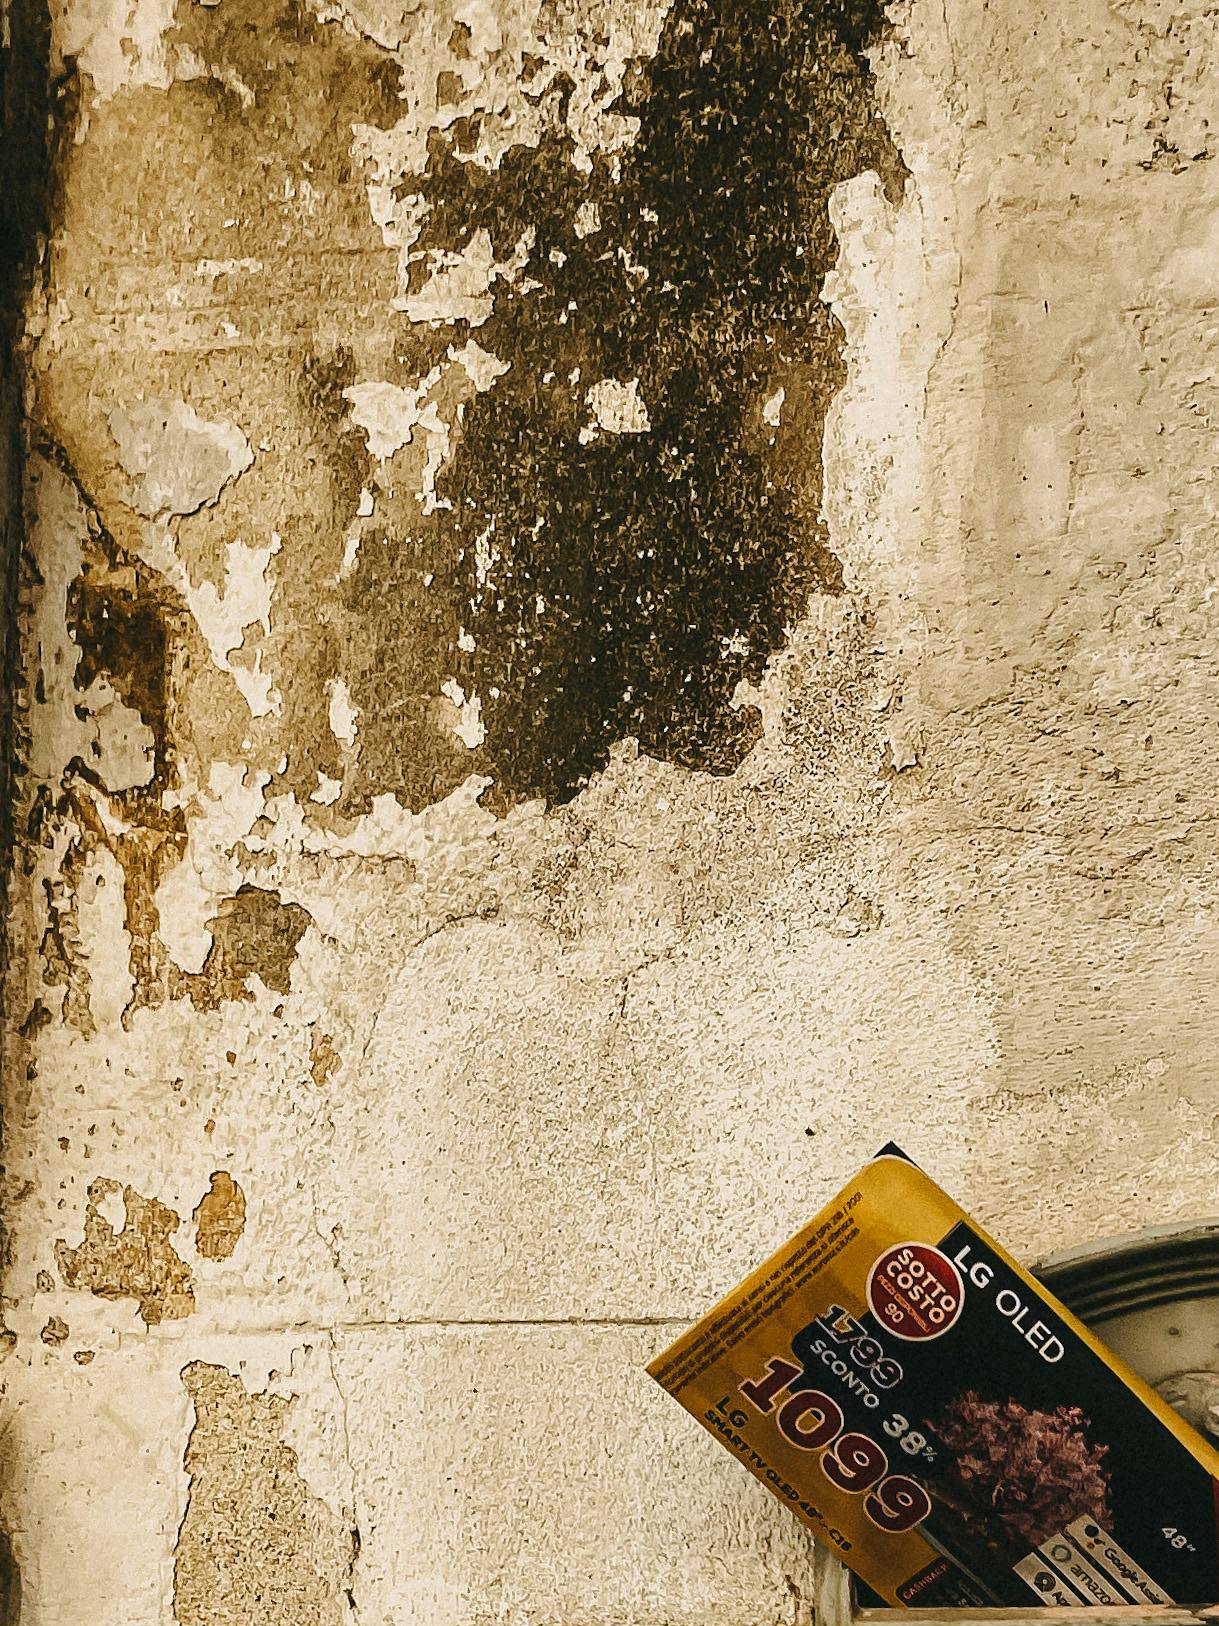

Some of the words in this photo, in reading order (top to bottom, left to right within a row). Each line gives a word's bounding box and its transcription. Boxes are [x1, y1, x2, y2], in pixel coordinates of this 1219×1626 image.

[887, 1262, 944, 1323] COSTO
[900, 1248, 957, 1312] SOTTO
[954, 1246, 994, 1288] LG
[996, 1290, 1064, 1362] OLED
[885, 1303, 904, 1323] 90
[810, 1340, 879, 1408] SCONTO
[816, 1302, 903, 1388] 1799
[705, 1410, 750, 1452] SMART
[749, 1452, 767, 1468] TV
[716, 1396, 748, 1428] LG
[737, 1356, 931, 1534] 1099
[1105, 1548, 1138, 1585] Google
